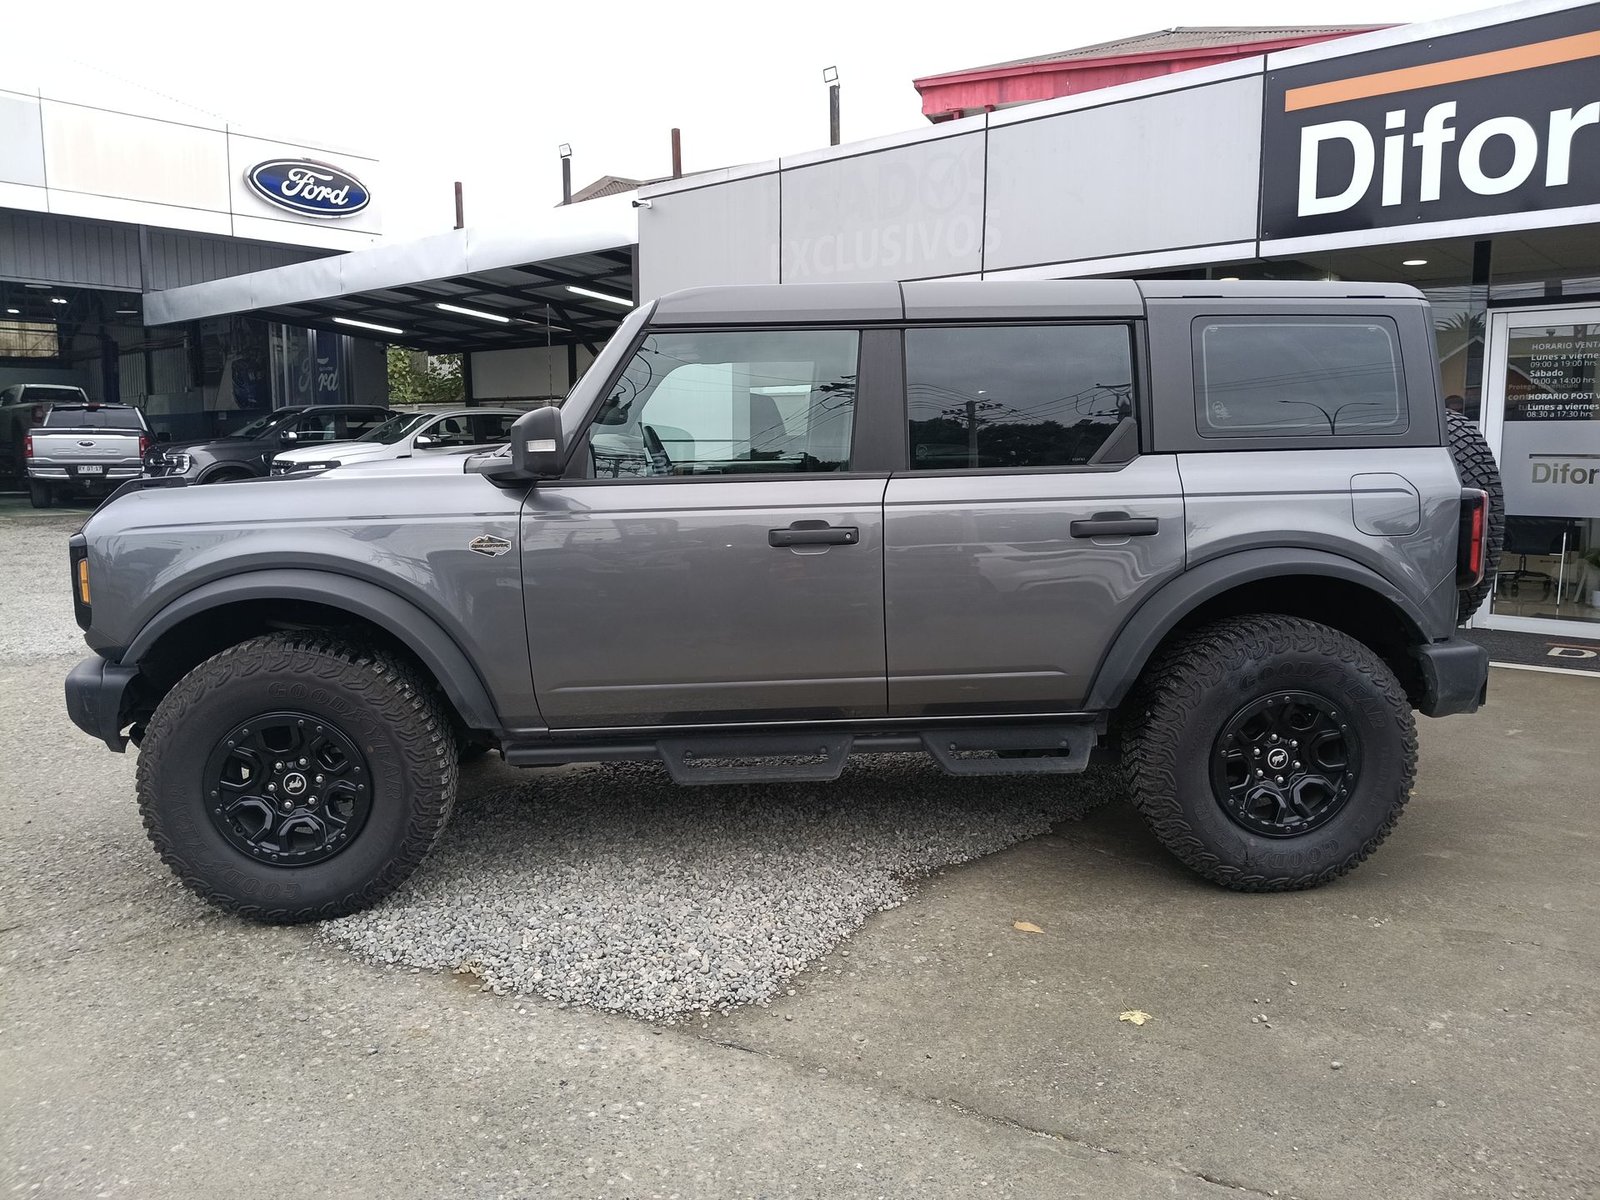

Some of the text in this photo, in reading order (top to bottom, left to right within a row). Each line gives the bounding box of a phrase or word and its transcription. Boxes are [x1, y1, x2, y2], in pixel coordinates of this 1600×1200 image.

[1297, 100, 1600, 217] Difor
[281, 168, 349, 206] Ford
[1530, 369, 1564, 377] Sábado
[1564, 402, 1600, 410] viernes
[1531, 462, 1600, 485] Difor
